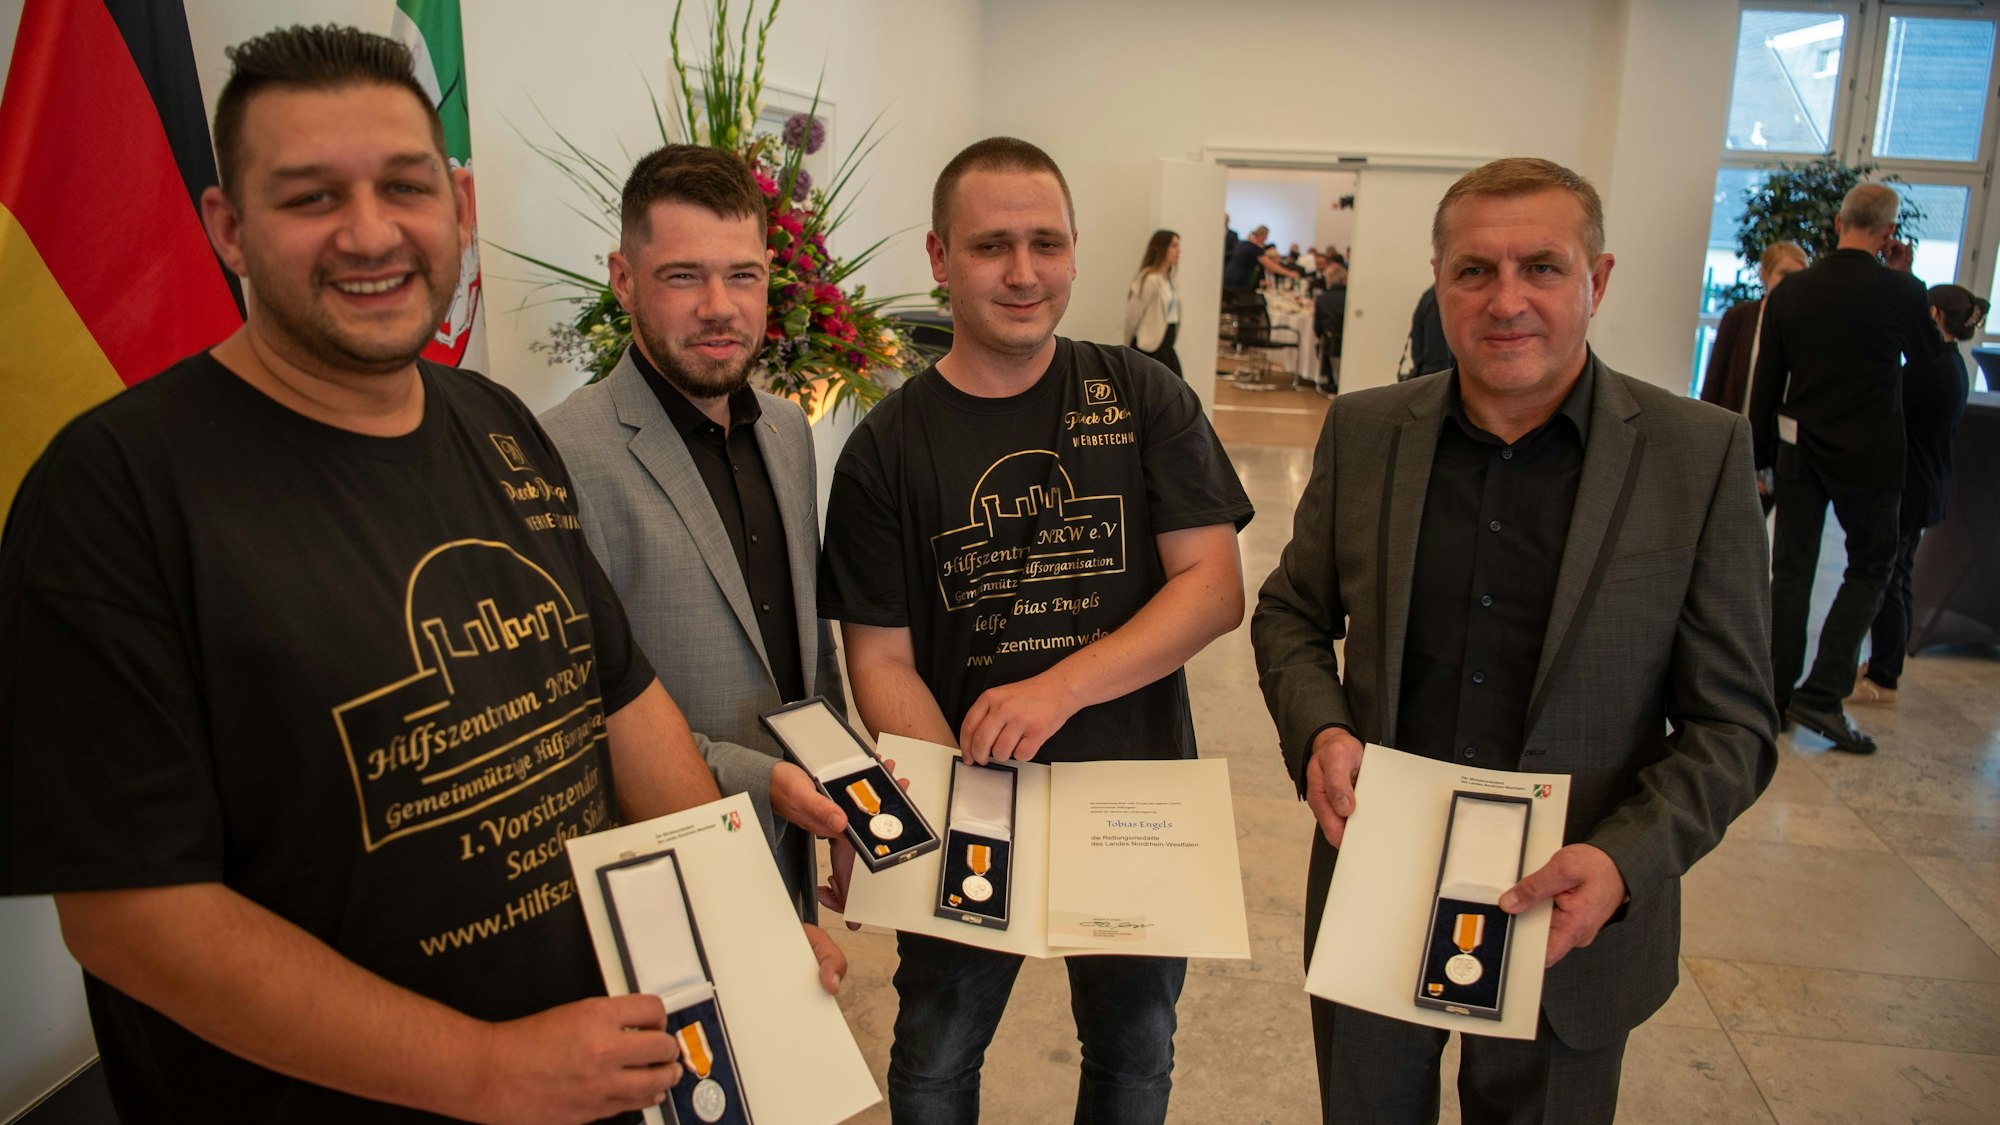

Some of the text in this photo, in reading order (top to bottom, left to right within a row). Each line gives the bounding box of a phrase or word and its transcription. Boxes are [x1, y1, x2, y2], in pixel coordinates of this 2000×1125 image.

[944, 546, 1031, 577] Hilfszentr
[1037, 525, 1085, 545] NRW
[1012, 599, 1047, 616] bias
[1052, 592, 1100, 615] Engels
[367, 691, 542, 781] Hilfszentrum
[385, 754, 534, 831] Gemeinnützige
[1106, 819, 1173, 831] Tobias Engels
